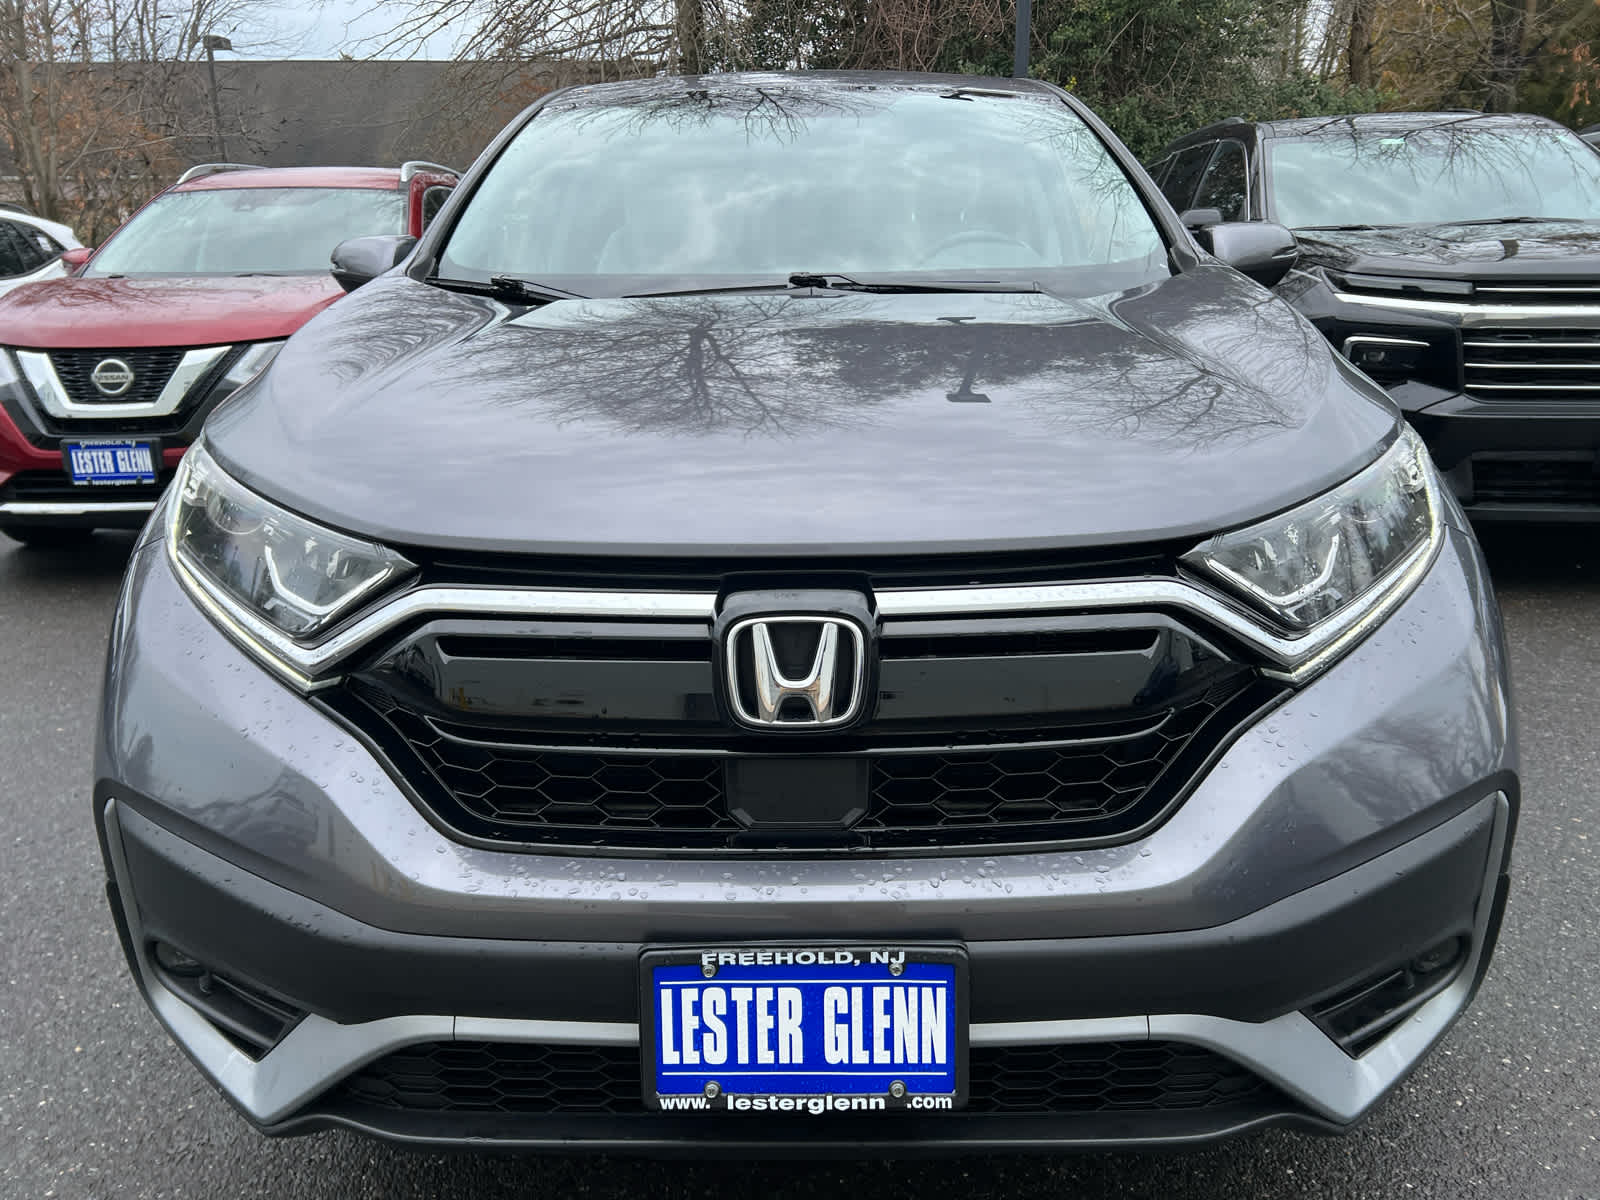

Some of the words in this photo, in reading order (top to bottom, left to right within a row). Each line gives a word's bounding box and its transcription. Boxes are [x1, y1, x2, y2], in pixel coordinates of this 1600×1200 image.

[94, 373, 129, 381] NISSAN
[71, 451, 115, 474] LESTER
[116, 449, 153, 473] GLENN
[701, 952, 860, 966] FREEHOLD,
[870, 951, 905, 965] NJ
[660, 987, 804, 1064] LESTER
[823, 986, 947, 1064] GLENN
[659, 1097, 711, 1109] www.
[727, 1095, 886, 1114] lesterglenn
[906, 1097, 953, 1109] .com
